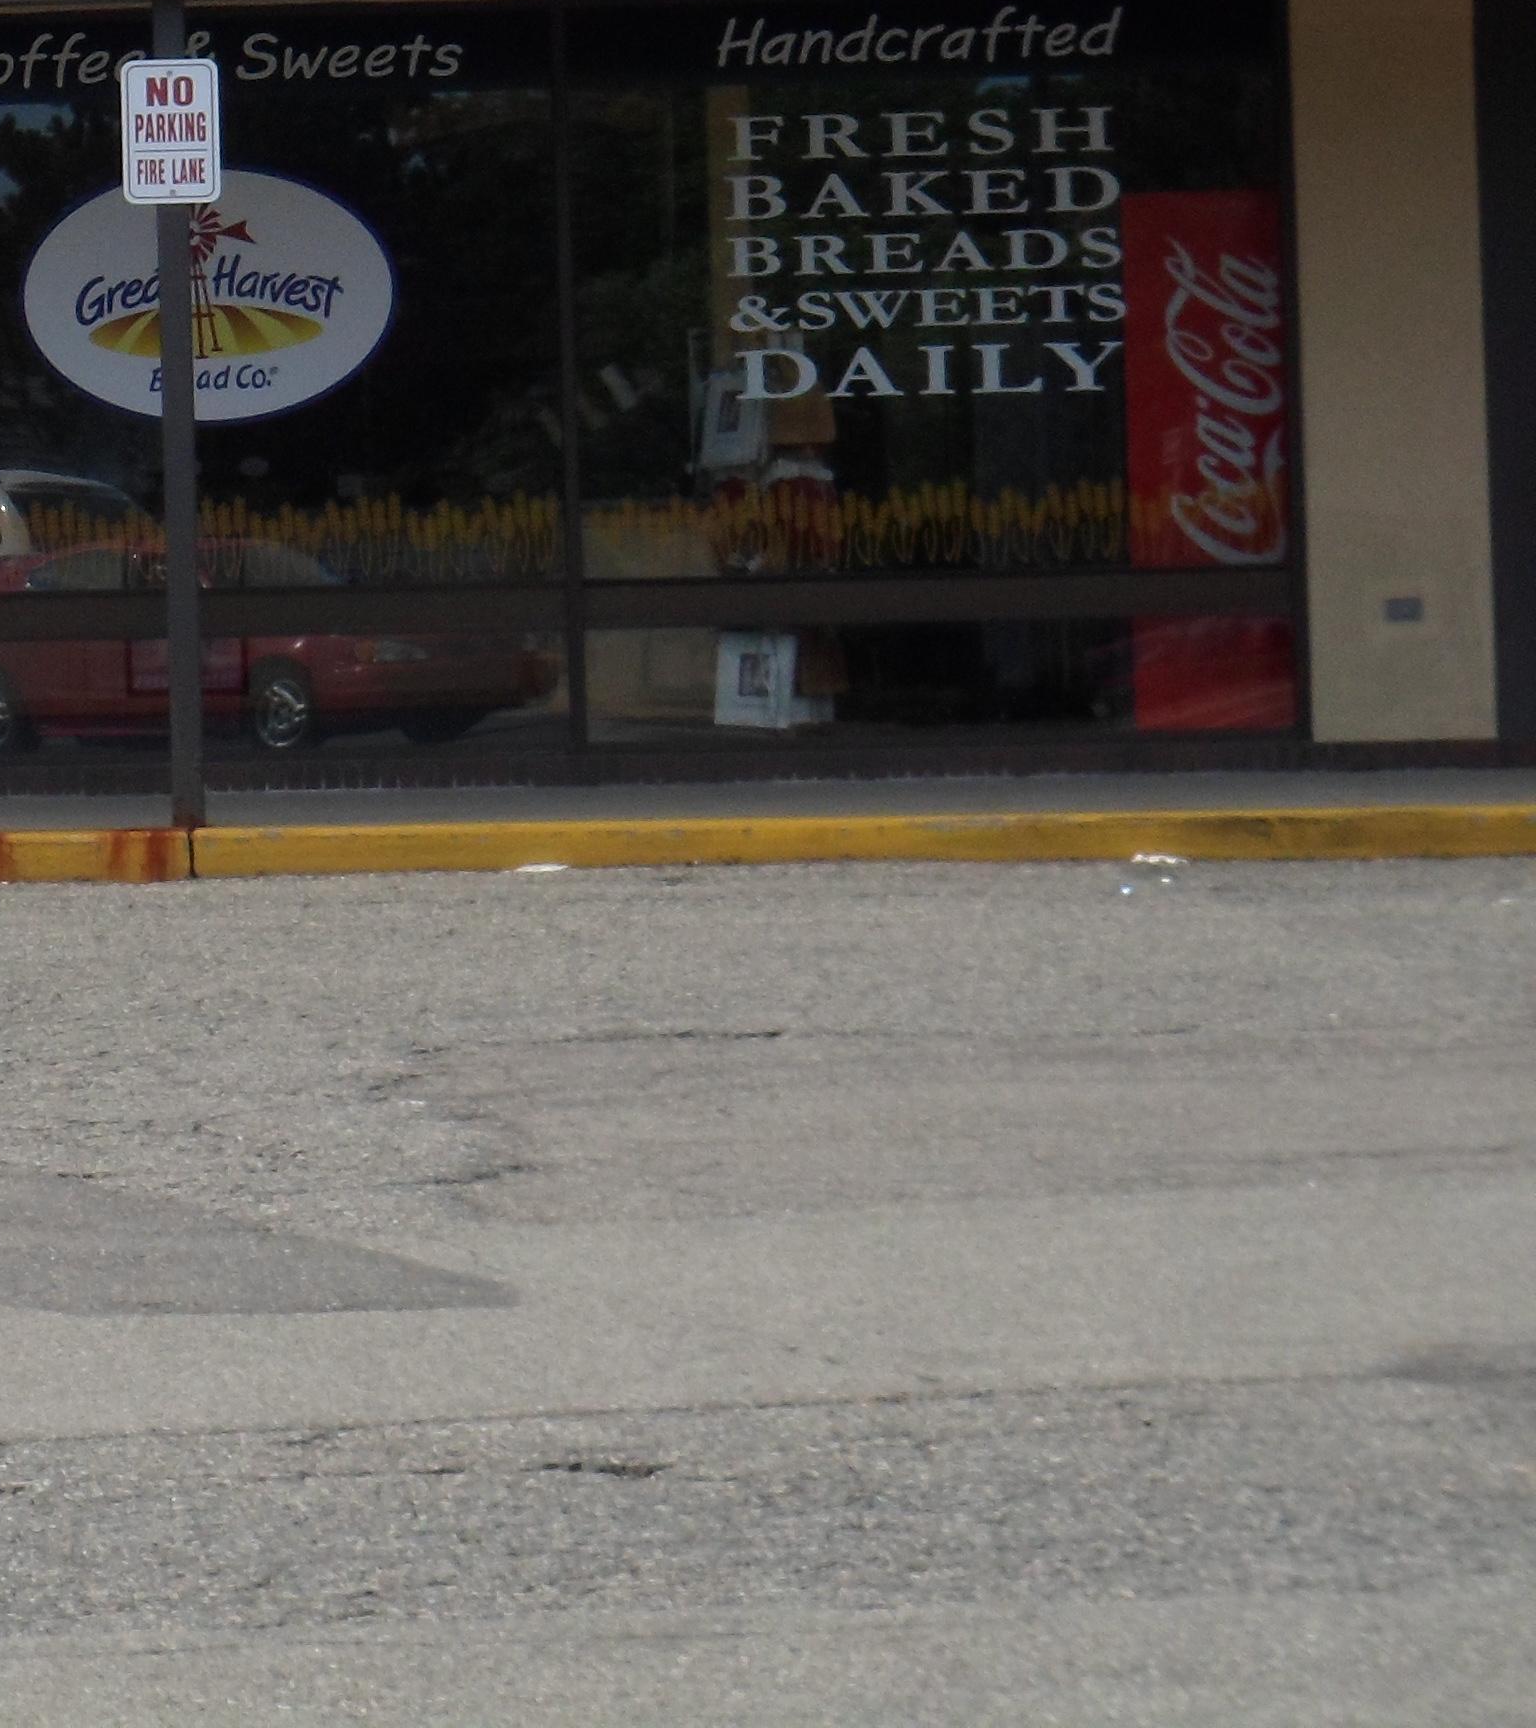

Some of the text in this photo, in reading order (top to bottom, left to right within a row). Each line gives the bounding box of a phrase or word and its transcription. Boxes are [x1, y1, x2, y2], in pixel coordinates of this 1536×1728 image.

[235, 32, 463, 80] Sweets
[717, 6, 1124, 66] Handcrafted
[146, 76, 193, 106] NO
[135, 112, 206, 143] PARKING
[728, 106, 1115, 161] FRESH
[137, 158, 206, 185] FIRE LANE
[724, 167, 1120, 220] BAKED
[727, 226, 1122, 276] BREADS
[76, 254, 344, 325] Grea Harvest
[149, 367, 235, 392] Bad
[736, 341, 1124, 401] DAILY
